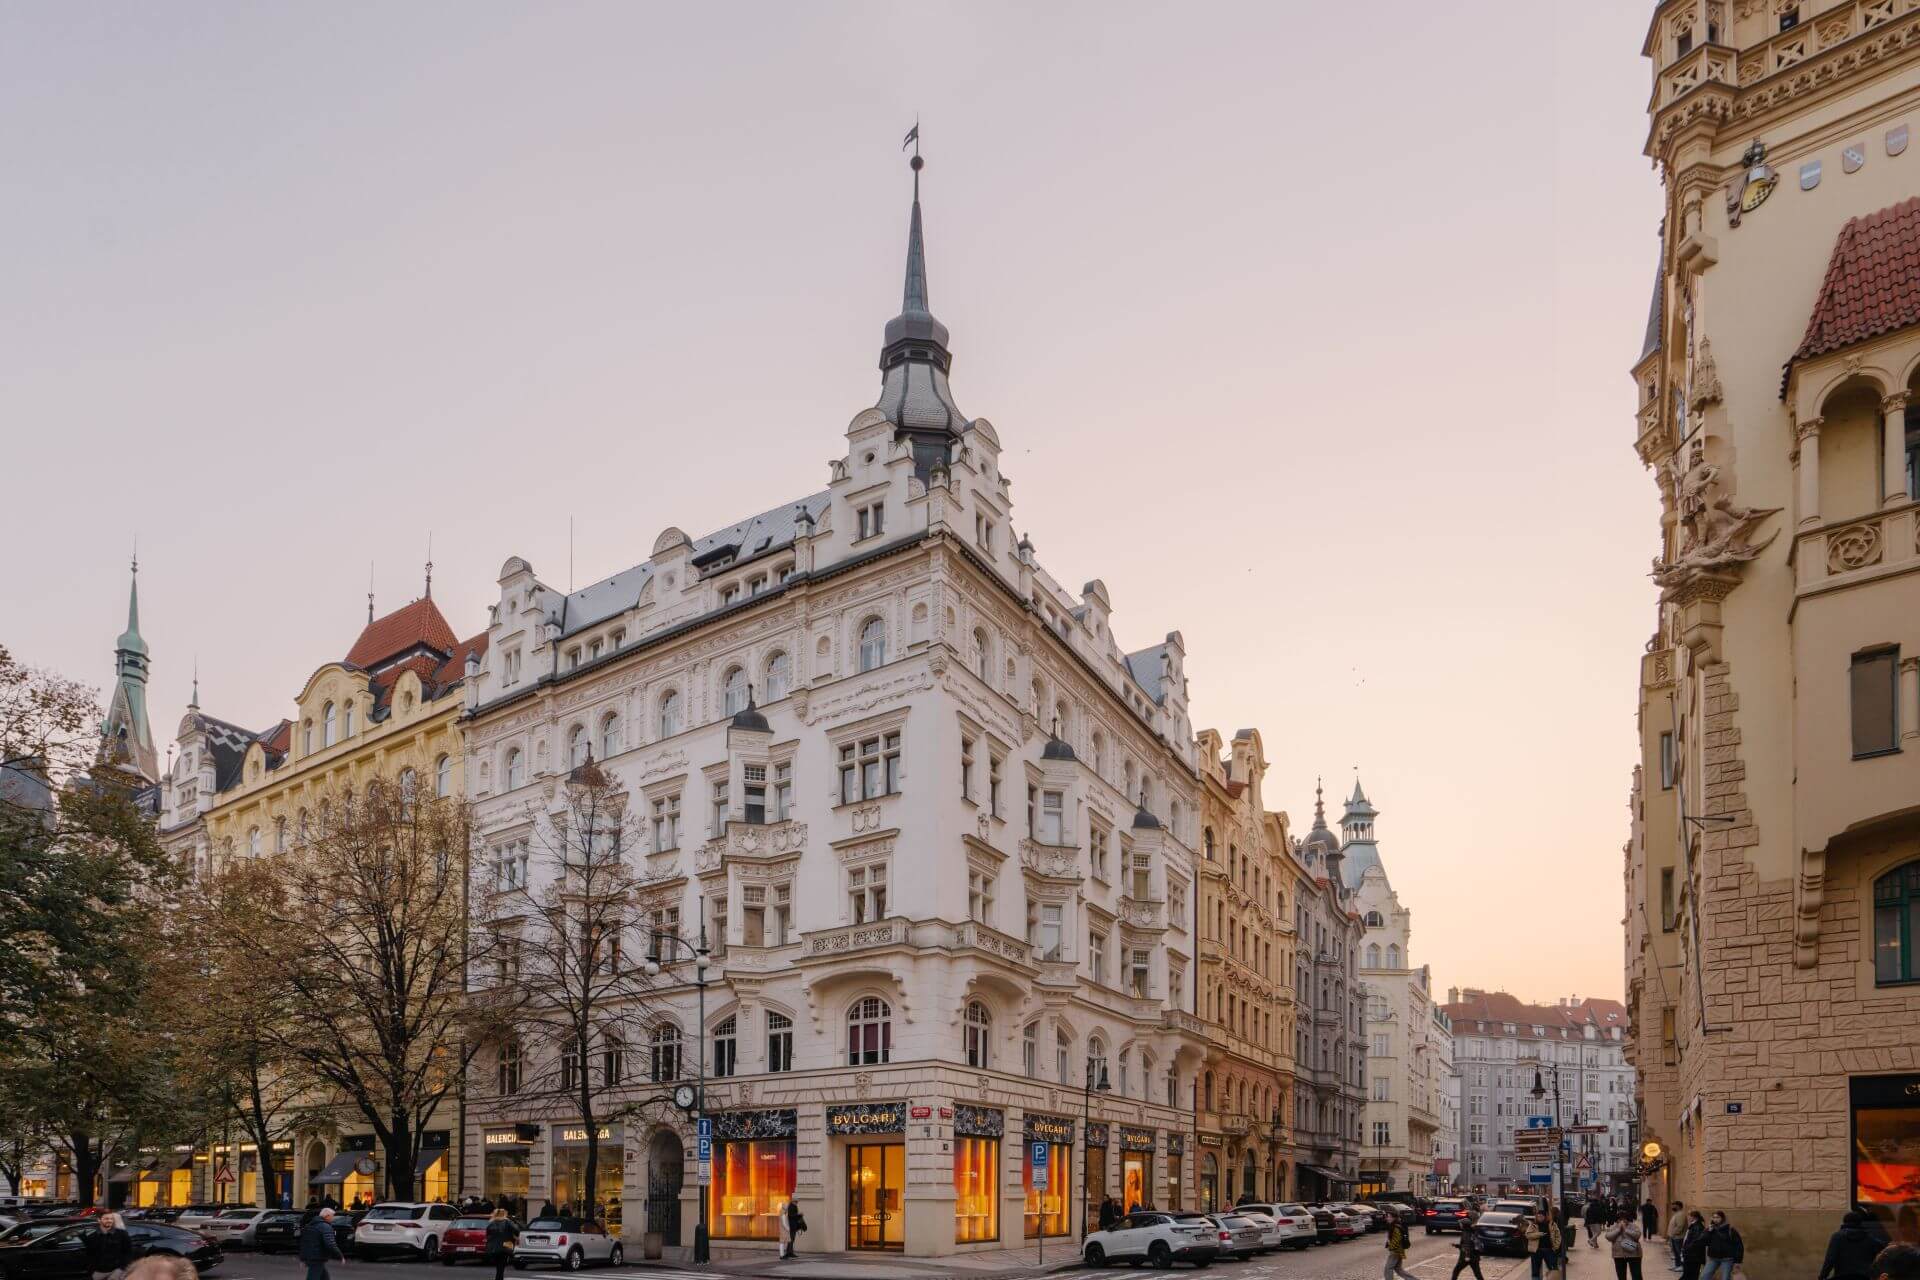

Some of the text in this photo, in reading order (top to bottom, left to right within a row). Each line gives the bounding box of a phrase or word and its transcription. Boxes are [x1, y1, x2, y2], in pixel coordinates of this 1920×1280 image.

[834, 1113, 897, 1125] BVLGARI
[564, 1129, 610, 1140] BALENGA
[701, 1140, 709, 1154] P
[1036, 1145, 1044, 1160] P
